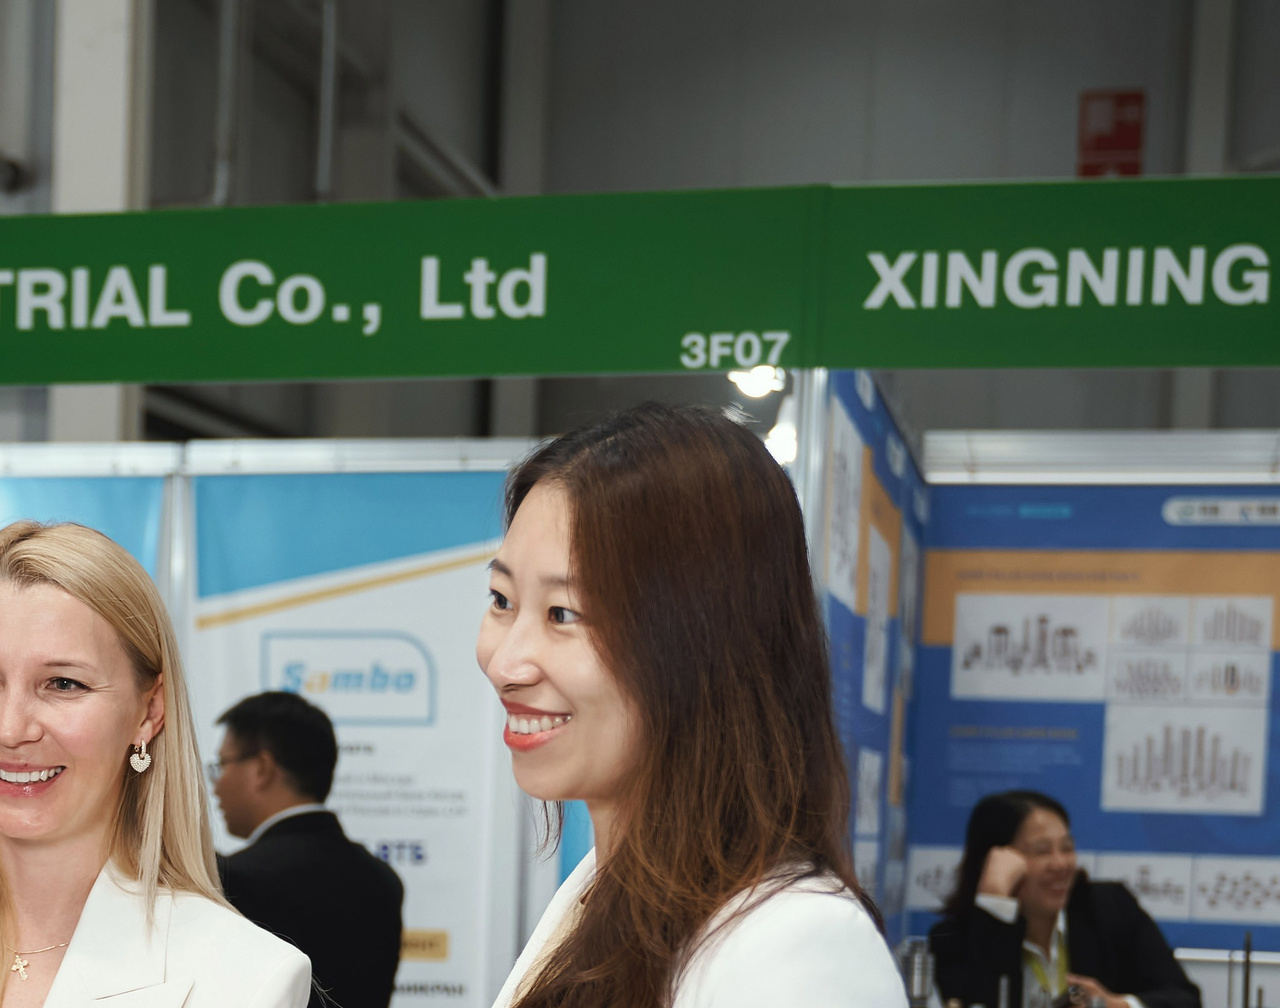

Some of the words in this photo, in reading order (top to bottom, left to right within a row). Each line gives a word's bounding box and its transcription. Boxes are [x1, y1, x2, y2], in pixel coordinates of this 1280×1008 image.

[219, 259, 381, 336] Co.,
[419, 251, 548, 320] Ltd
[862, 243, 1270, 310] XINGNING
[679, 331, 791, 369] 3F07
[280, 661, 416, 694] Sambo
